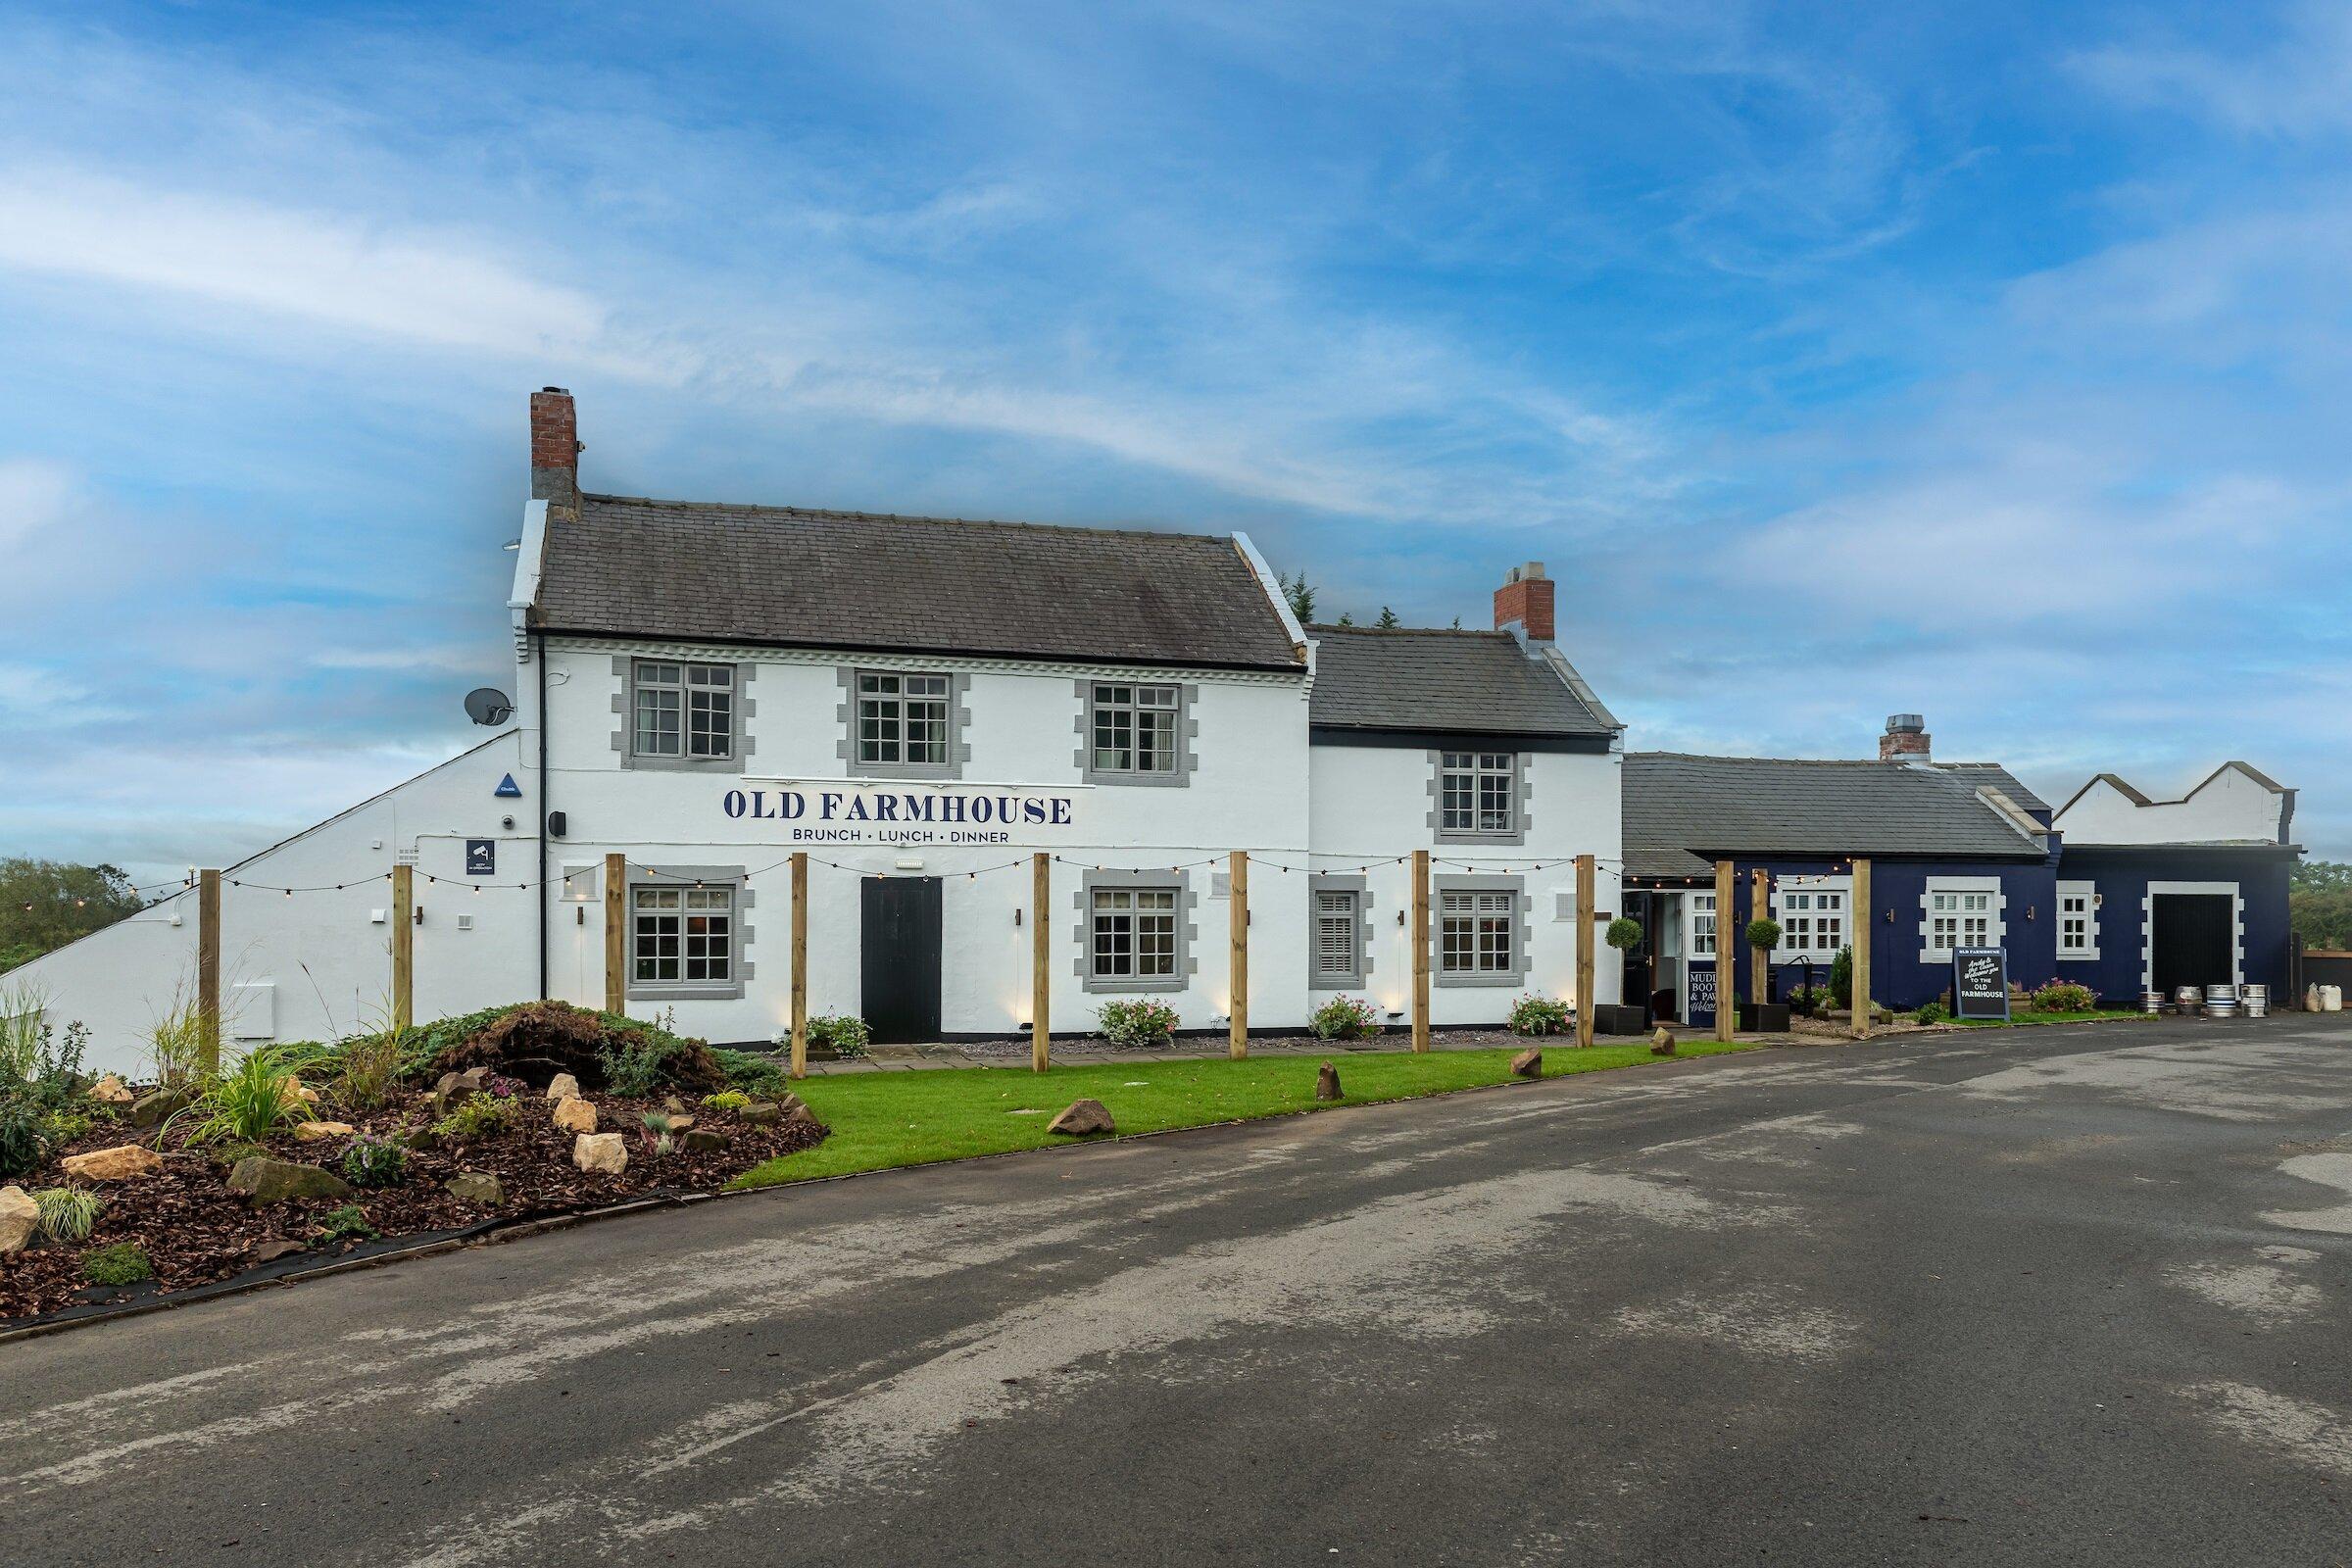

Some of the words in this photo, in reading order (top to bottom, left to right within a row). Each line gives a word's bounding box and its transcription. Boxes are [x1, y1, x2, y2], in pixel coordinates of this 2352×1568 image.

[723, 790, 806, 819] OLD
[819, 793, 1071, 825] FARMHOUSE
[793, 828, 860, 841] BRUNCH
[878, 830, 933, 842] LUNCH
[951, 831, 1009, 843] DINNER
[1969, 958, 1985, 968] Andy
[1690, 992, 1698, 1001] &
